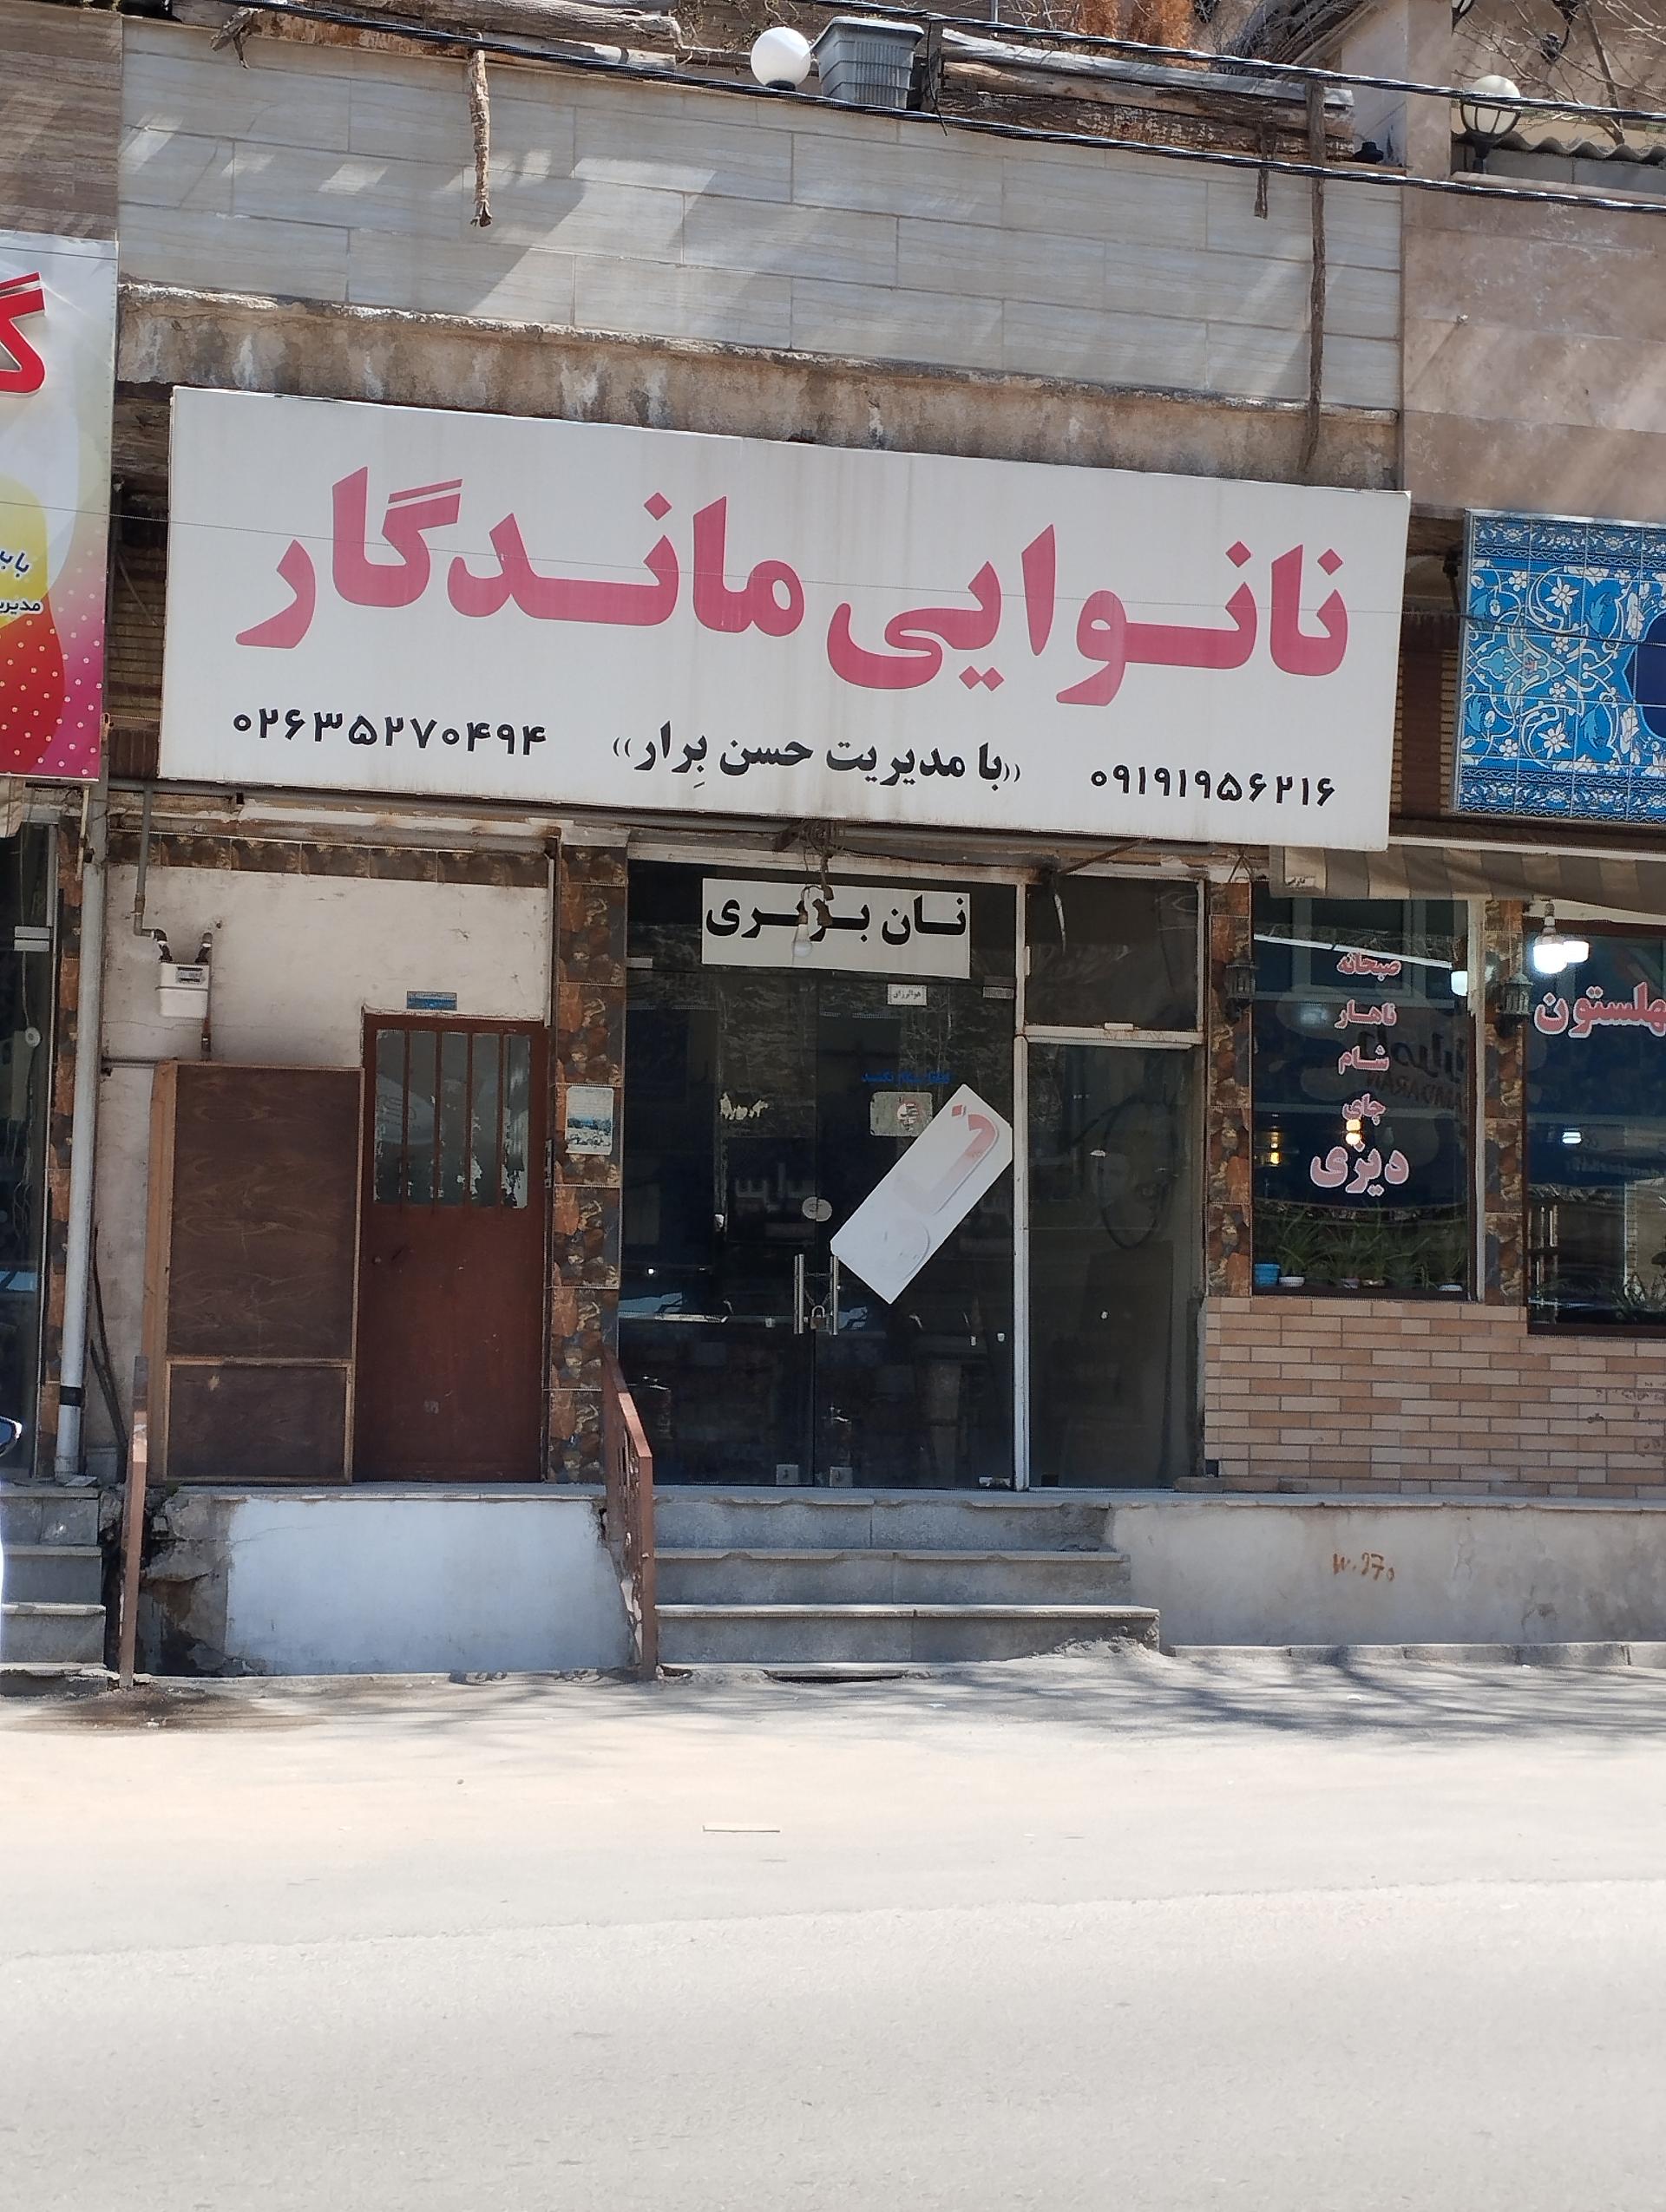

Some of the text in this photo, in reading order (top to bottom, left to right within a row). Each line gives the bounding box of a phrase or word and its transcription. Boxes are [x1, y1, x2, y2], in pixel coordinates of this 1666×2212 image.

[235, 466, 1348, 707] نانوایی ماندگار
[233, 707, 548, 756] ۰۲۶۳۵۲۷۰۴۹۴
[719, 739, 814, 776] حسن
[826, 741, 966, 786] مدیریت
[1090, 763, 1336, 808] ۰۹۱۹۱۹۵۶۲۱۶
[882, 893, 967, 946] نان
[1337, 952, 1401, 982] صبحانه
[1334, 999, 1397, 1029] ناهار
[1534, 981, 1666, 1038] هلستون
[1338, 1045, 1390, 1075] شام
[1310, 1139, 1410, 1197] دیزی
